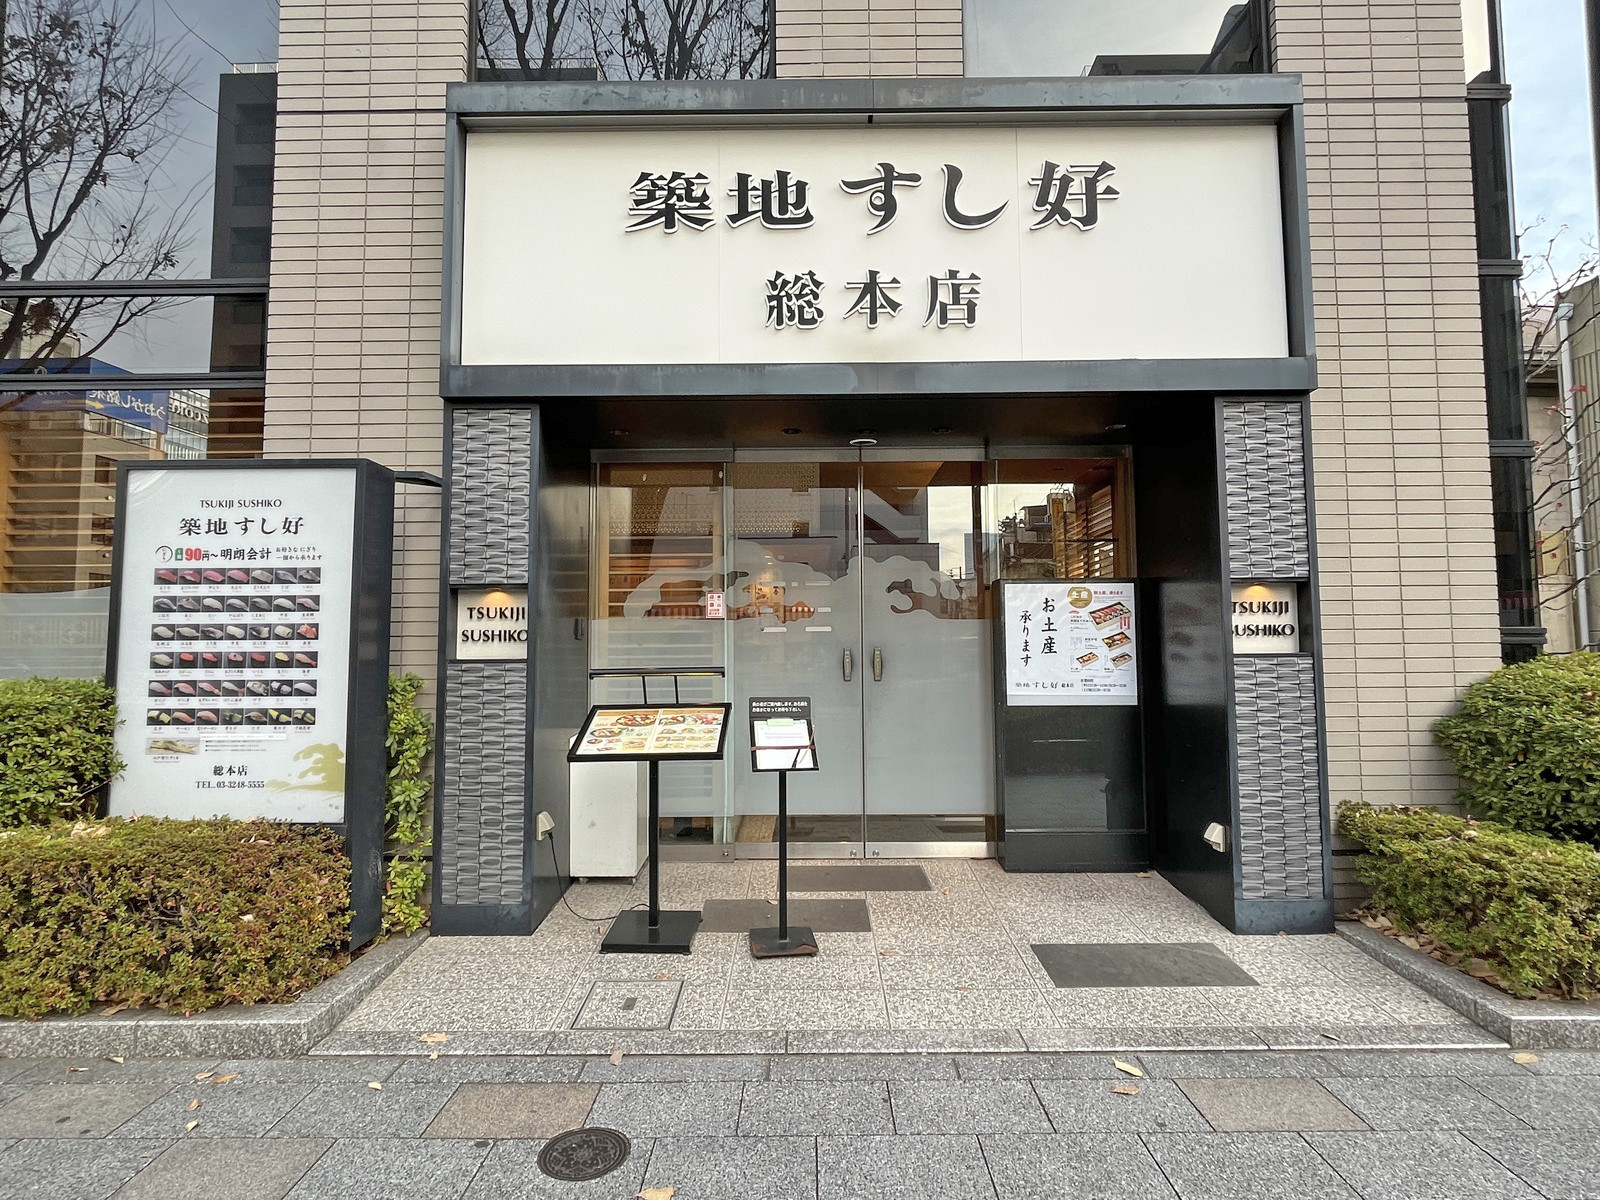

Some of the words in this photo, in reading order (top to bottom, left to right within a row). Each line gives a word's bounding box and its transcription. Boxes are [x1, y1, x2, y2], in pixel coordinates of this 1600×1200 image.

[624, 159, 1120, 236] 築地すし好
[764, 268, 982, 330] 総本店
[200, 499, 234, 509] TSUKIJI
[237, 498, 282, 508] SUSHIKO
[179, 516, 305, 536] 築地すし好
[466, 606, 526, 621] TSUKIJI
[1231, 600, 1289, 616] TSUKIJI
[1041, 597, 1058, 655] お土産
[1231, 623, 1295, 637] USHIKO
[461, 629, 528, 642] SUSHIKO
[1019, 610, 1032, 668] 承ります
[213, 764, 248, 776] 総本店
